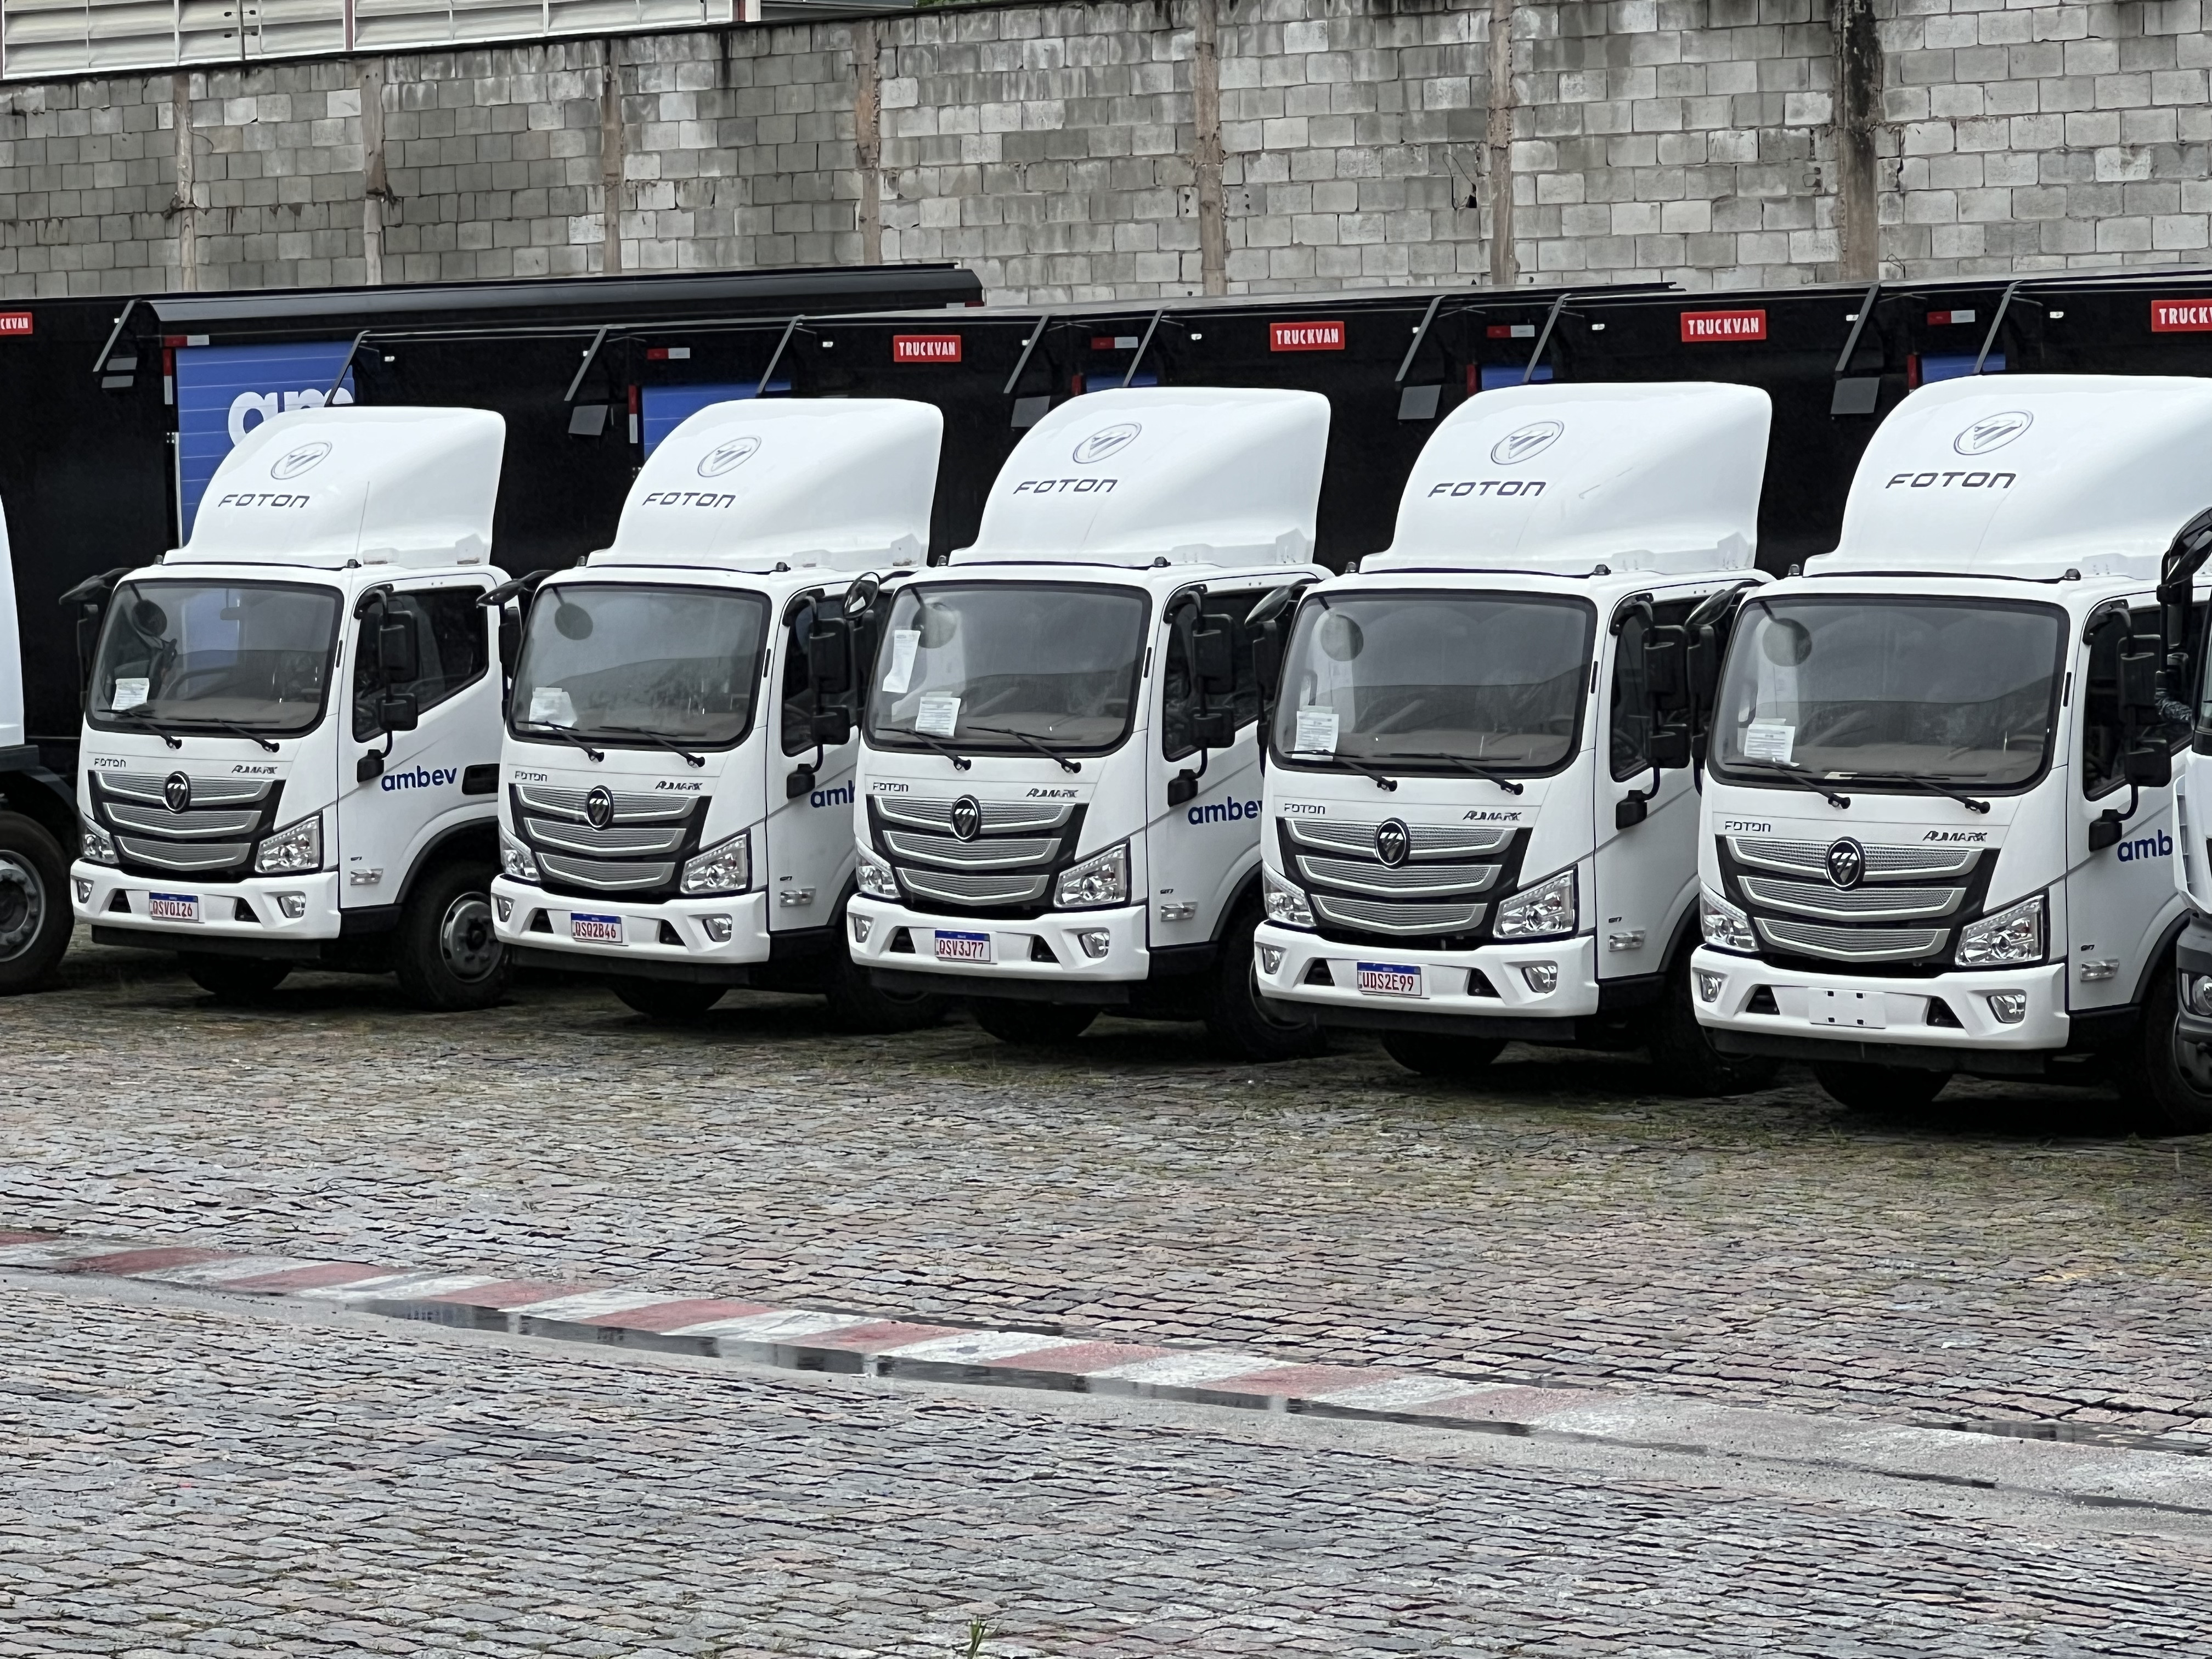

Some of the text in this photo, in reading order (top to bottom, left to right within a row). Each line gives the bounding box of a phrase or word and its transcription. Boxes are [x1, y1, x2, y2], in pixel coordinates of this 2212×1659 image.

[1688, 317, 1759, 335] TRUCKVAN
[1276, 328, 1339, 345] TRUCKVAN
[899, 341, 956, 356] TRUCKVAN
[1013, 479, 1118, 494] FOTON
[1886, 472, 2017, 489] FOTON
[1427, 481, 1547, 498] FOTON
[218, 494, 311, 509] FOTON
[642, 492, 736, 509] FOTON
[94, 758, 126, 768] FOTON
[381, 766, 458, 792] ambev
[515, 771, 548, 782] FOTON
[873, 782, 909, 793] FOTON
[1284, 803, 1325, 815] FOTON
[1725, 821, 1771, 833] FOTON
